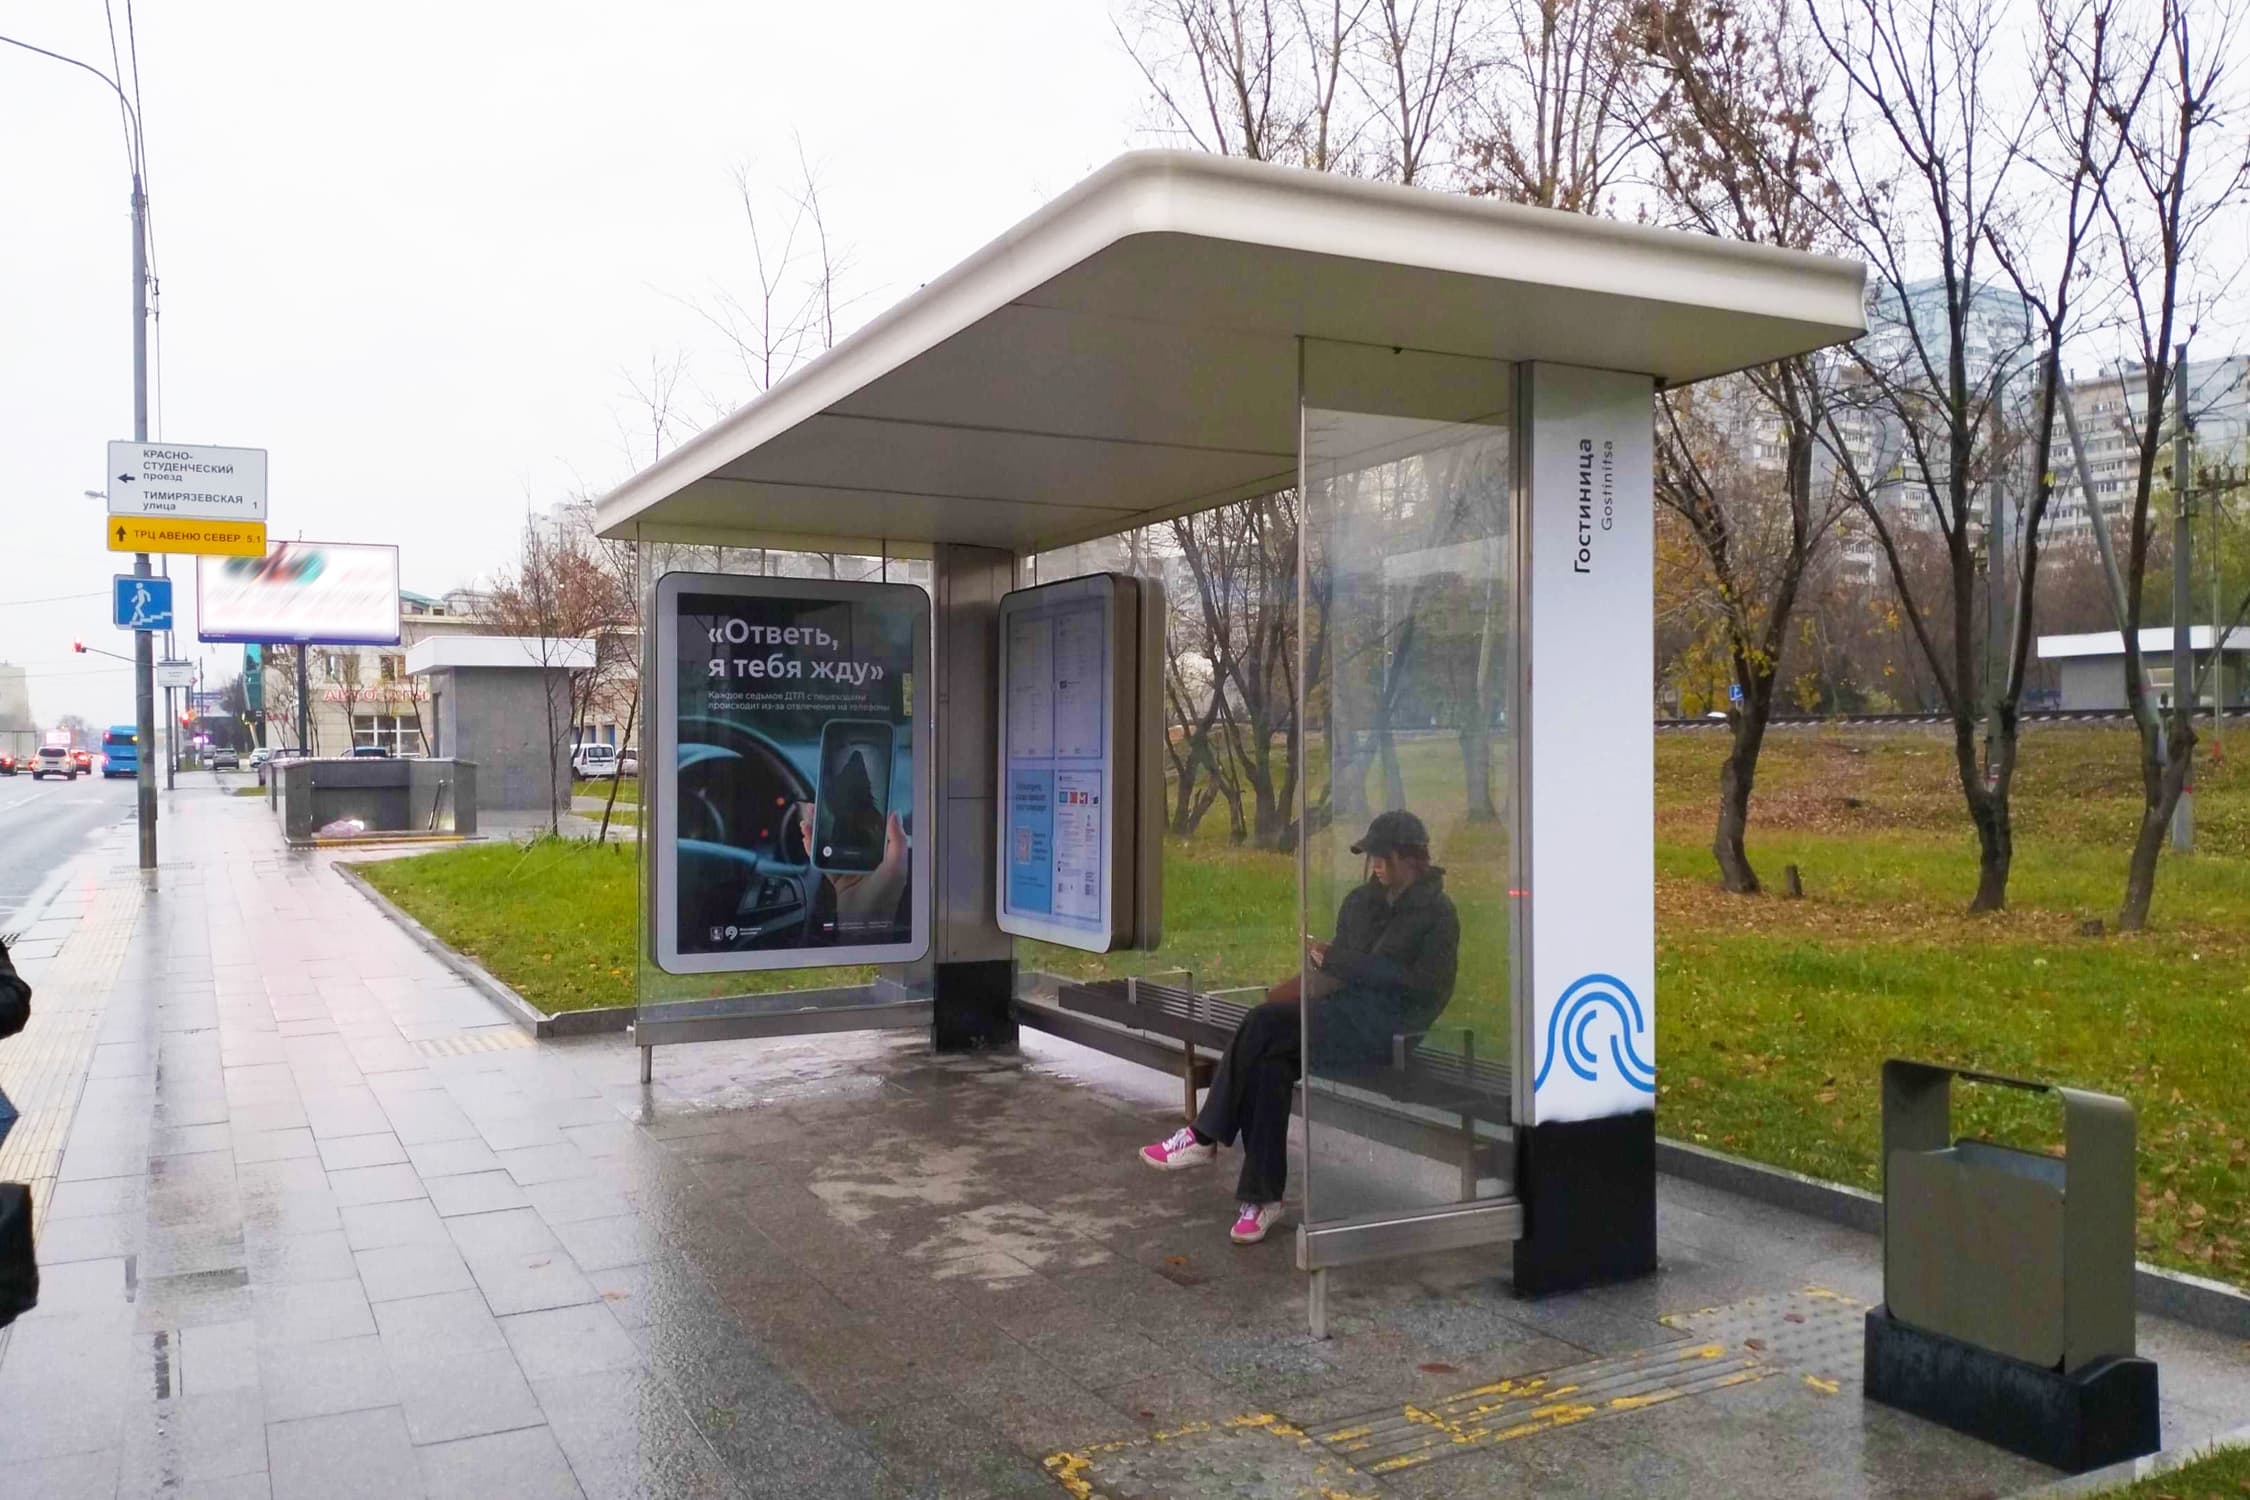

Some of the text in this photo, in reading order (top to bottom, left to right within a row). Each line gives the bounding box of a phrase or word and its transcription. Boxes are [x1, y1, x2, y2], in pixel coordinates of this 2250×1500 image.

[143, 449, 193, 461] КРАСНО-
[143, 461, 234, 474] СТУДЕНЧЕСКИЙ
[143, 473, 183, 482] проезд
[1601, 440, 1613, 531] Gostinitsa
[143, 490, 243, 505] ТИМИРЯЗЕВСКАЯ
[143, 501, 176, 511] улица
[1574, 438, 1595, 573] Гостиница
[133, 529, 156, 540] ТРЦ
[159, 531, 201, 542] АВЕНЮ
[204, 533, 241, 543] СЕВЕР
[708, 618, 839, 650] «Ответь,
[708, 653, 884, 686] я тебя жду»
[708, 691, 744, 700] Каждое
[784, 691, 805, 701] ДТП
[708, 702, 760, 711] происходит
